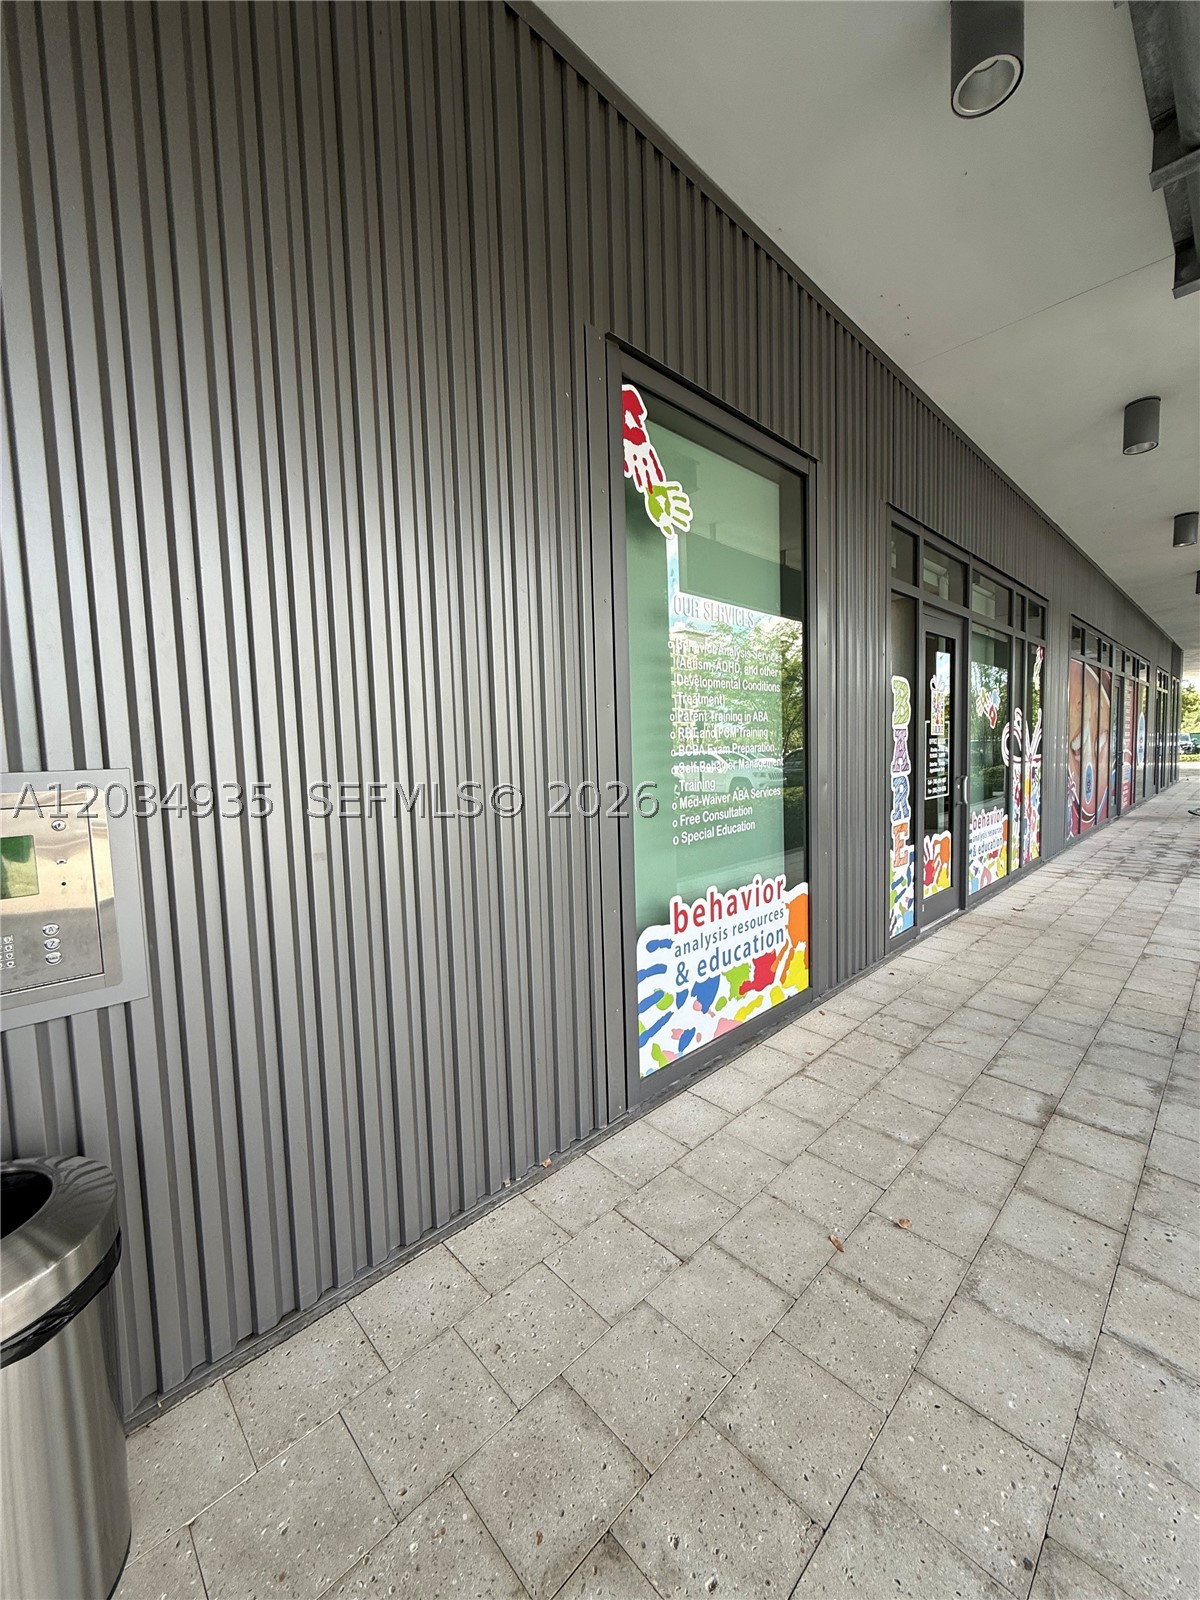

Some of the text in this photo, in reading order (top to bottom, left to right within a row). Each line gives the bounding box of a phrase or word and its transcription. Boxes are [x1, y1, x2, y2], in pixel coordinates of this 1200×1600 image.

[674, 594, 754, 628] OUR SERVICES
[717, 645, 751, 661] Analysis
[751, 650, 782, 663] Services
[744, 666, 758, 676] and
[760, 667, 778, 677] other
[677, 674, 780, 692] Developmental Conditions
[677, 710, 708, 721] Parent
[710, 711, 742, 724] Training
[744, 713, 751, 721] in
[752, 711, 768, 721] ABA
[678, 727, 697, 739] RBT
[700, 728, 715, 739] and
[718, 728, 736, 738] PCM
[739, 727, 768, 739] Training
[679, 744, 705, 756] BCBA
[708, 743, 730, 754] Exam
[732, 743, 774, 754] Preparation
[739, 757, 784, 771] Management
[893, 680, 910, 868] BARE
[679, 779, 715, 792] Training
[679, 793, 730, 809] Med-Waiver
[732, 790, 749, 801] ABA
[751, 787, 781, 799] Services
[680, 814, 701, 826] Free
[702, 805, 753, 822] Consultation
[973, 810, 1003, 830] behavior
[681, 826, 714, 845] Special
[716, 821, 755, 836] Education
[673, 879, 784, 934] behavior
[674, 907, 784, 958] analysis resources
[675, 926, 784, 986] & education
